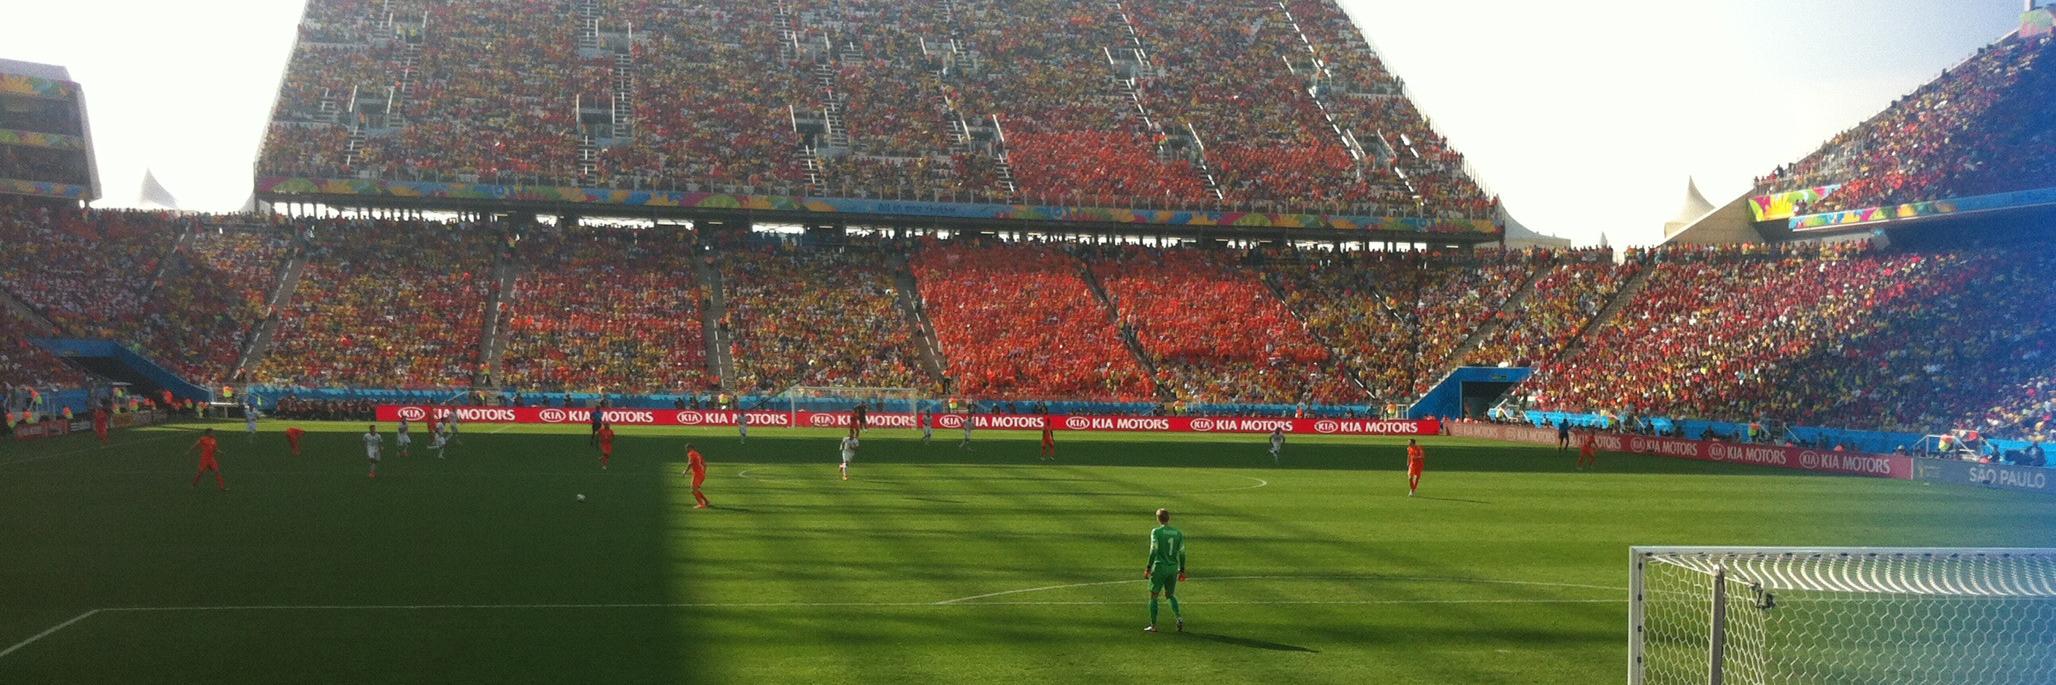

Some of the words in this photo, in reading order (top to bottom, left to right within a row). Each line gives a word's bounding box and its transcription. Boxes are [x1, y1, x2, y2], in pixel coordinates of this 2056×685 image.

[456, 408, 516, 421] MOTORS
[569, 410, 591, 422] KIA
[705, 412, 729, 424] KIA
[990, 416, 1045, 428] MOTORS
[1092, 418, 1114, 429] KIA
[1117, 418, 1169, 430] MOTORS
[1216, 419, 1238, 431] KIA
[1240, 420, 1293, 431] MOTORS
[1340, 421, 1363, 432] KIA
[1365, 421, 1418, 433] MOTORS
[1646, 439, 1661, 453] KIA
[1662, 441, 1698, 456] MOTORS
[1727, 446, 1743, 461] KIA
[1745, 448, 1787, 465] MOTORS
[1821, 454, 1841, 469] KIA
[1842, 456, 1890, 474] MOTORS
[1969, 464, 1996, 484] SÃO
[1999, 469, 2046, 489] PAULO
[1167, 537, 1175, 556] 1
